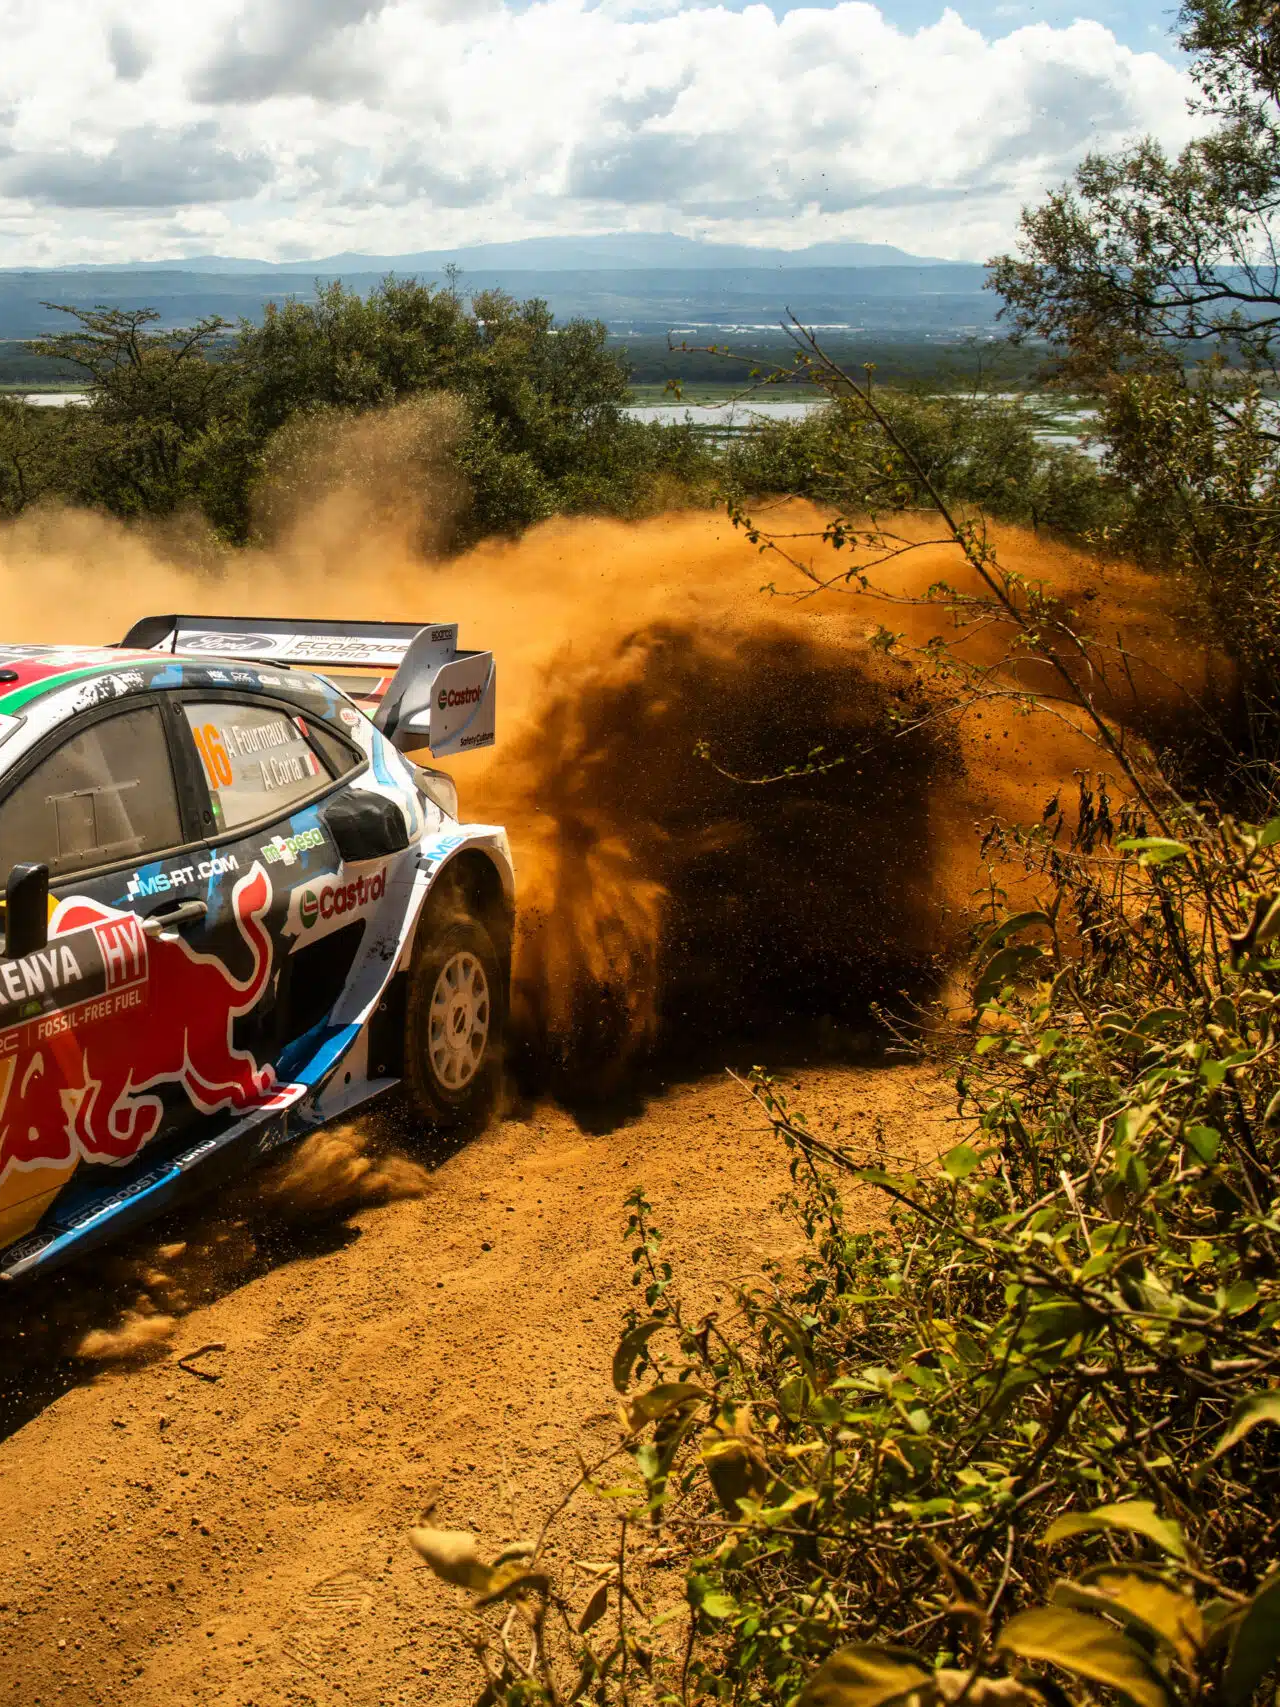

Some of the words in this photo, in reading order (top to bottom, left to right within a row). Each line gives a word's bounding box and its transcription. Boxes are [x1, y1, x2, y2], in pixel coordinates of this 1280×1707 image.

[187, 634, 258, 651] Ford
[286, 649, 370, 659] HYBRID
[295, 641, 408, 653] ECOBOOS
[448, 685, 481, 707] Castrol
[193, 723, 232, 789] 16
[221, 728, 236, 758] A
[232, 720, 290, 756] Fourmaux
[259, 760, 274, 791] A
[270, 753, 302, 786] Coria
[138, 855, 239, 897] MS-RT.COM
[320, 866, 387, 919] Castrol
[100, 921, 140, 983] HY
[38, 999, 111, 1040] FOSSIL-FREE
[115, 989, 141, 1013] FUEL
